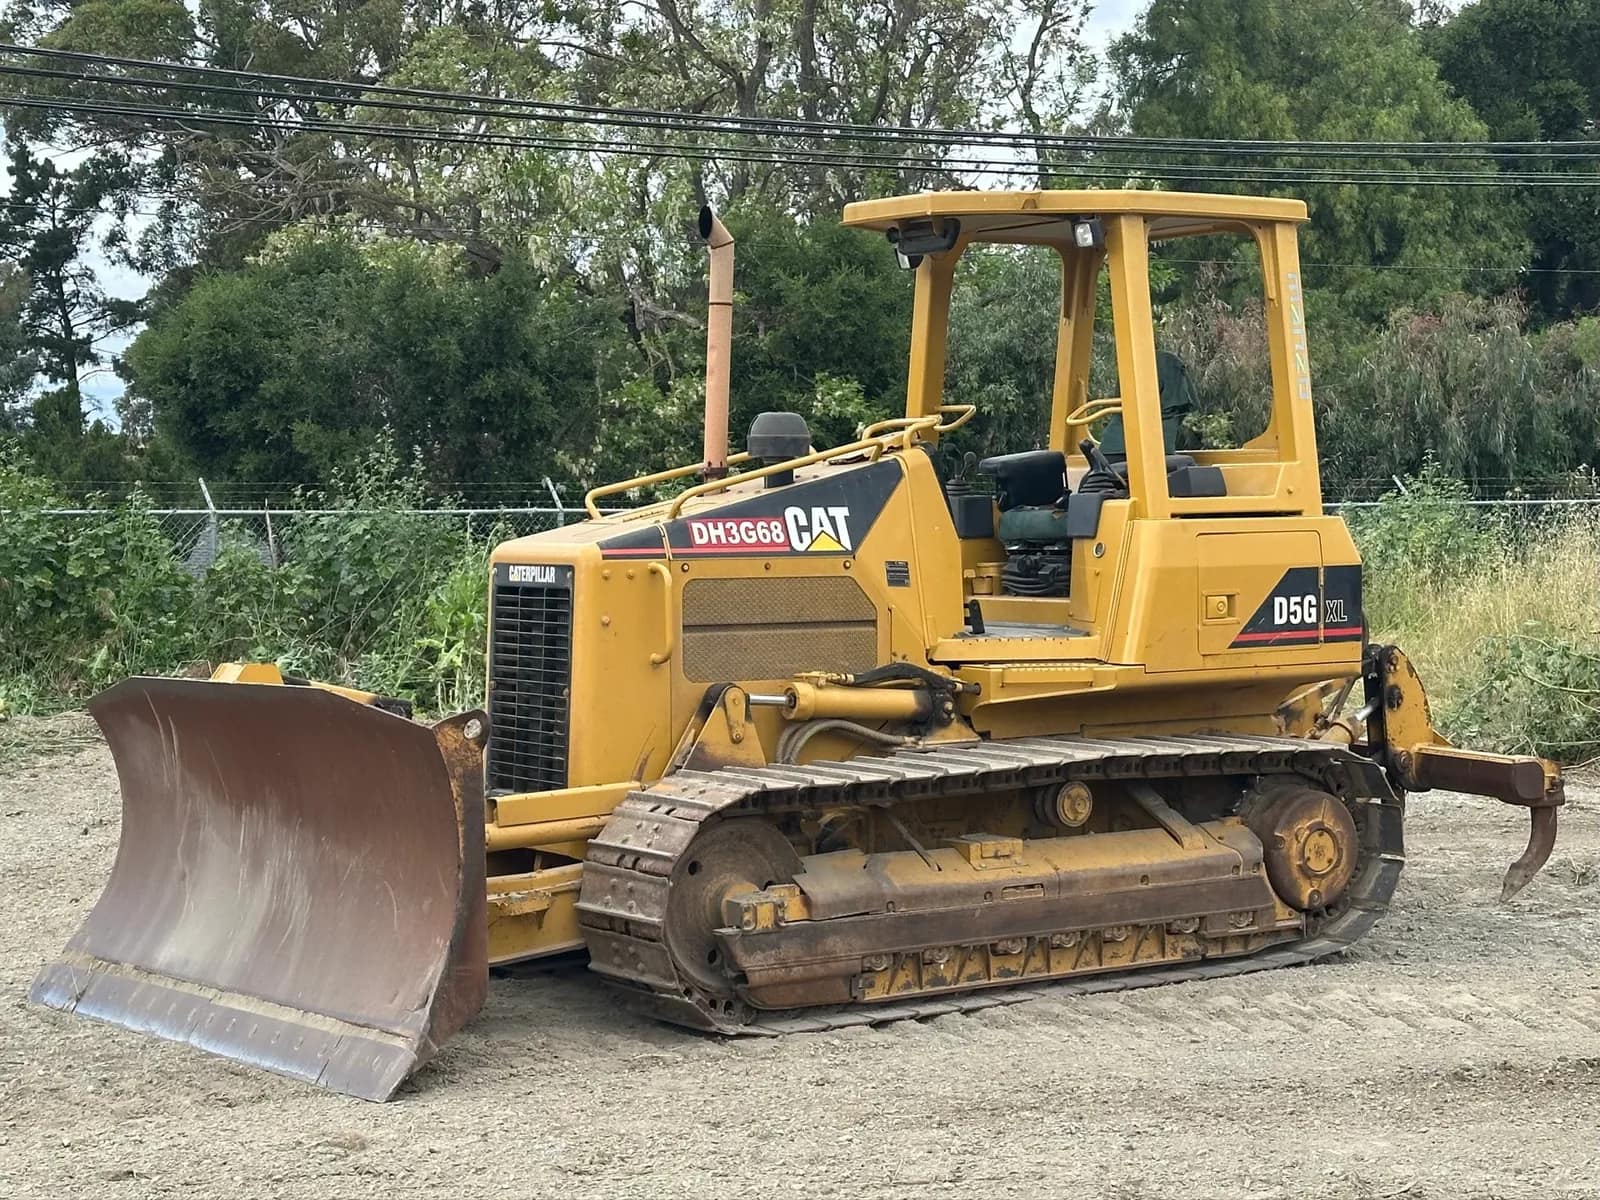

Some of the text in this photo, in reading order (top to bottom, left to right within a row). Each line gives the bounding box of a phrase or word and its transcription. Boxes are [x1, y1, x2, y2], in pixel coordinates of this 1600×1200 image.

[691, 521, 785, 545] DH3G68
[784, 506, 852, 551] CAT
[508, 565, 556, 583] CATERPILLAR
[1273, 594, 1348, 625] D5G XL
